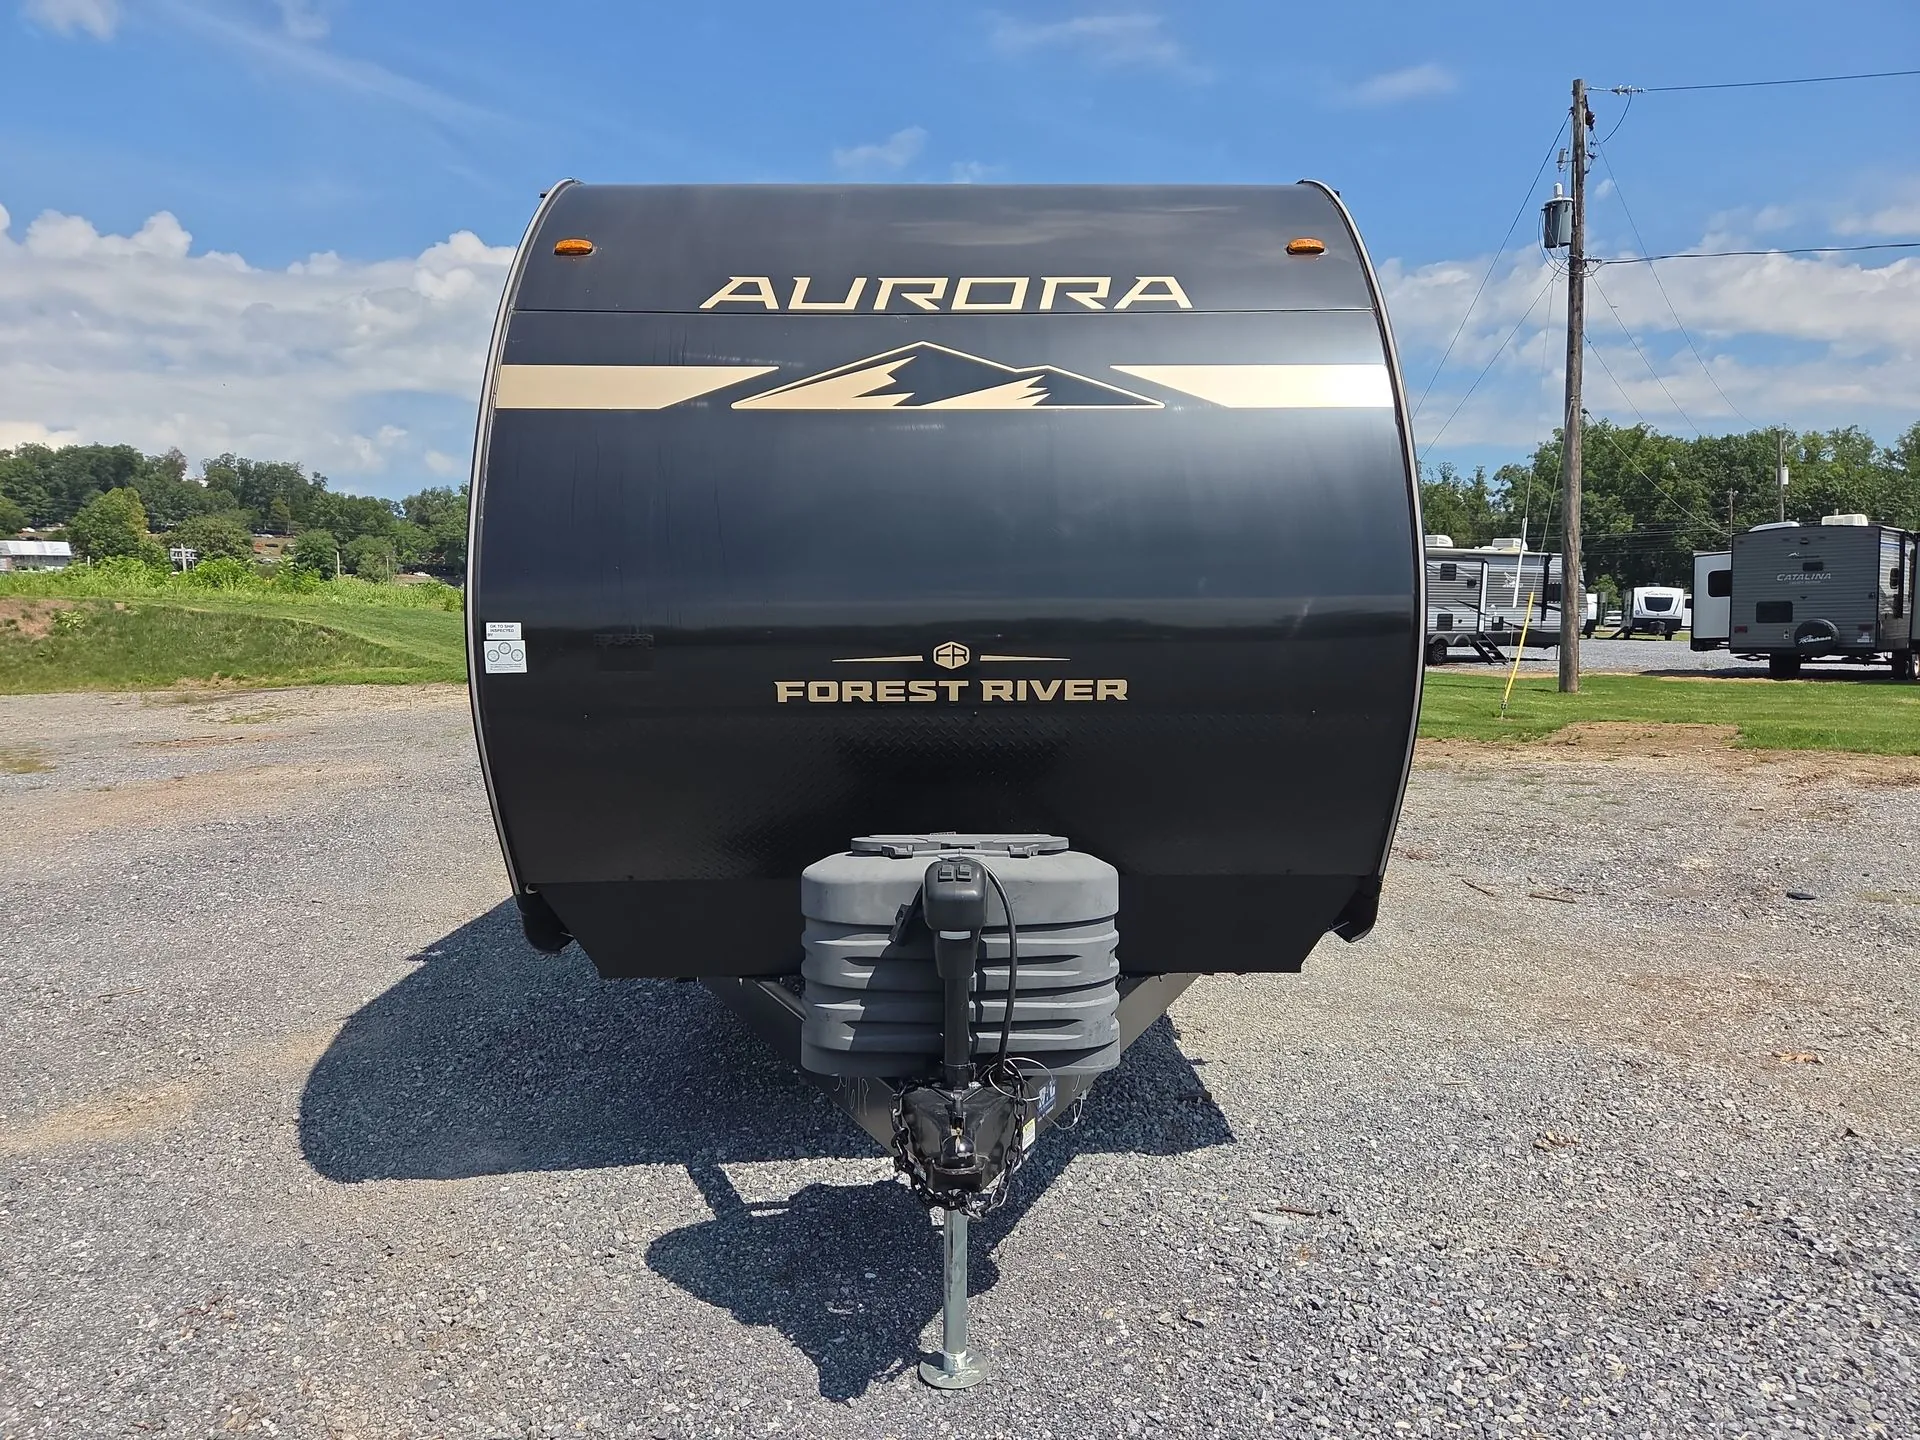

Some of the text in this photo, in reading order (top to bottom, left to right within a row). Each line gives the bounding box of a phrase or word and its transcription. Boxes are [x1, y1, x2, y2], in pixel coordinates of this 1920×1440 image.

[699, 275, 1194, 311] AURORA
[1776, 572, 1832, 582] CATALINA
[774, 679, 1129, 703] FOREST RIVER
